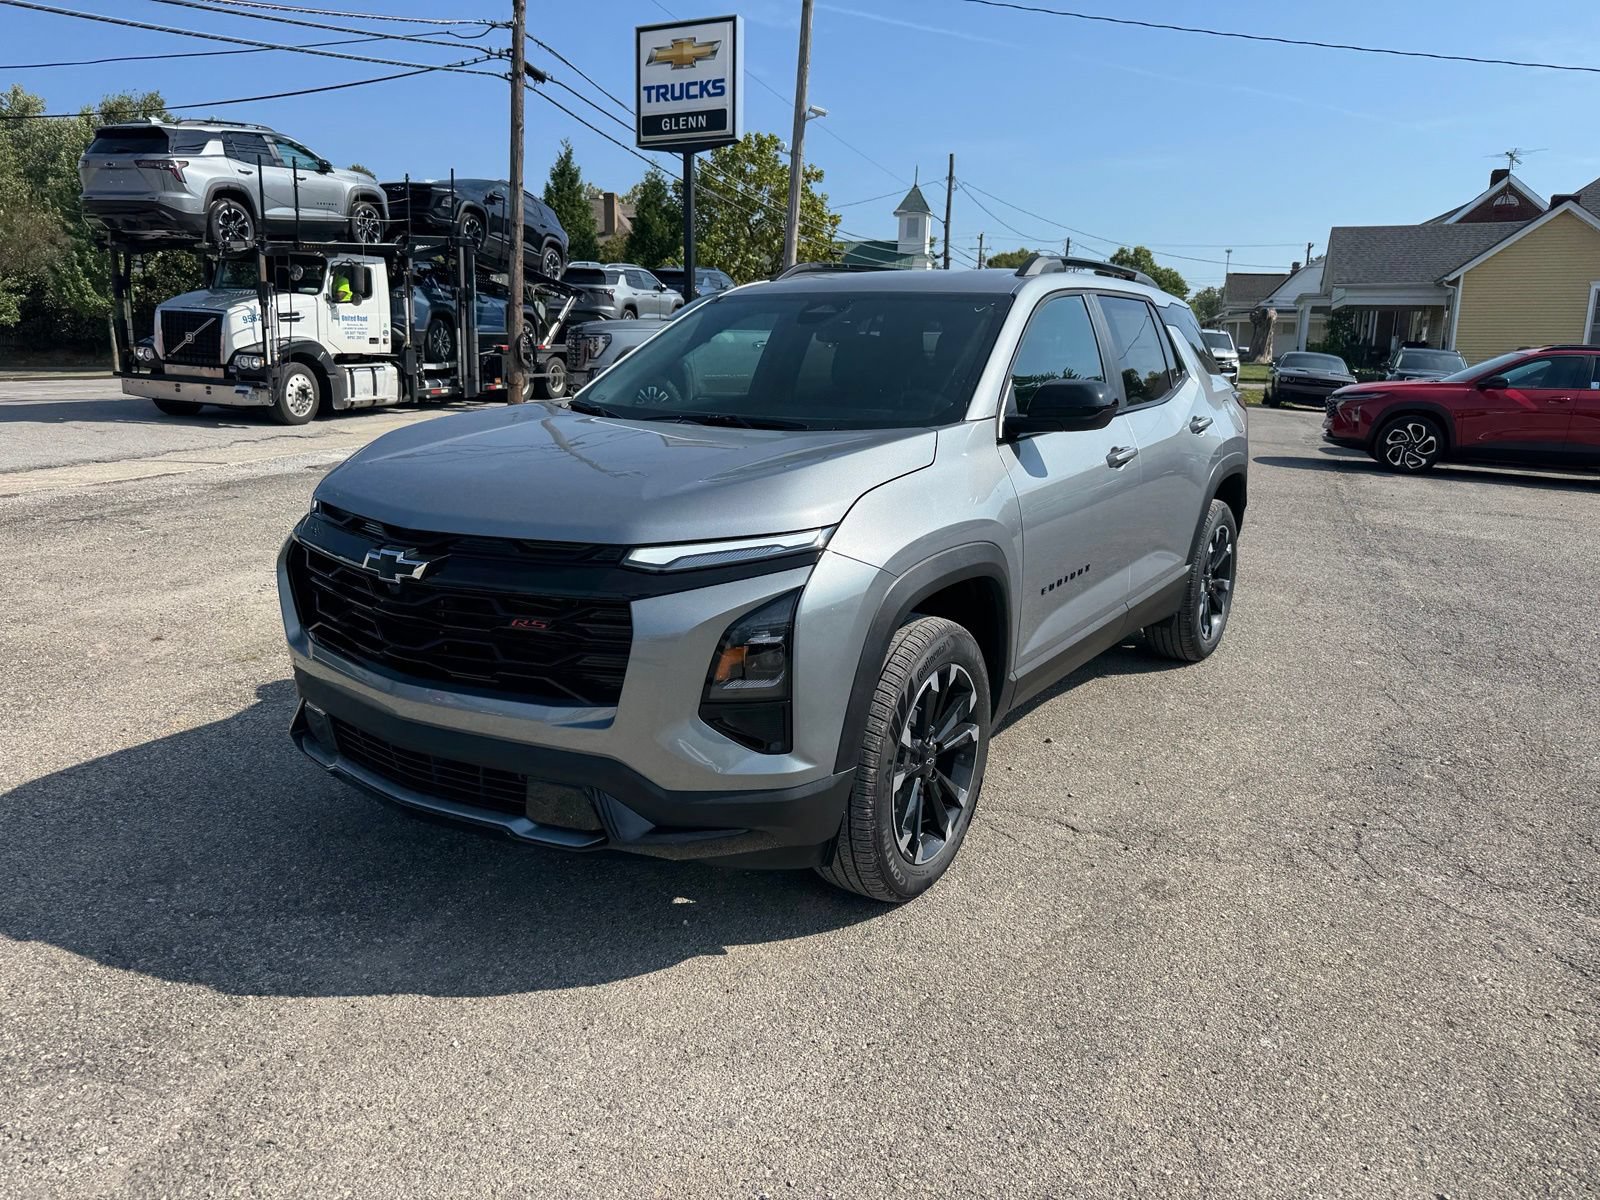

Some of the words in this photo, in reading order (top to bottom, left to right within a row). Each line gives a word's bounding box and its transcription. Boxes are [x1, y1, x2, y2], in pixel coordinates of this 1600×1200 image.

[643, 78, 725, 103] TRUCKS
[661, 115, 707, 131] GLENN
[511, 619, 546, 629] RS
[917, 641, 947, 682] Continental
